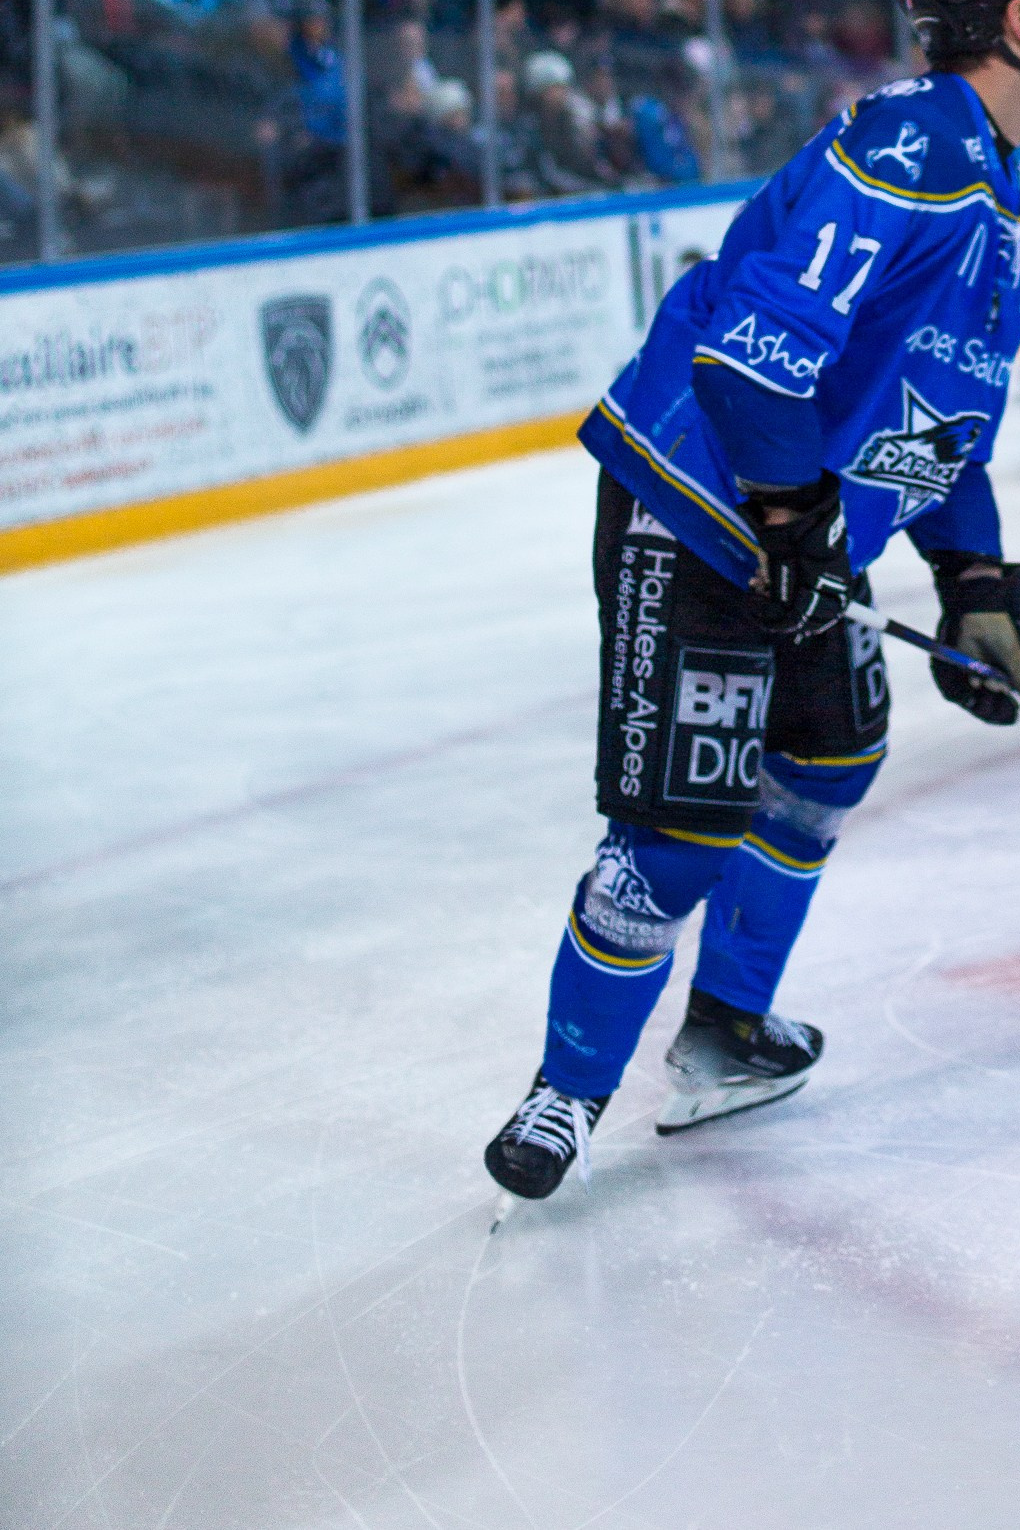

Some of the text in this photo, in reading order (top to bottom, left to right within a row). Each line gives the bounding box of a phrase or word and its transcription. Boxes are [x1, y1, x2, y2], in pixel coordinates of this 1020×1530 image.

[798, 222, 882, 315] 17
[609, 544, 639, 711] le département
[619, 548, 677, 798] Hautes-Alpes
